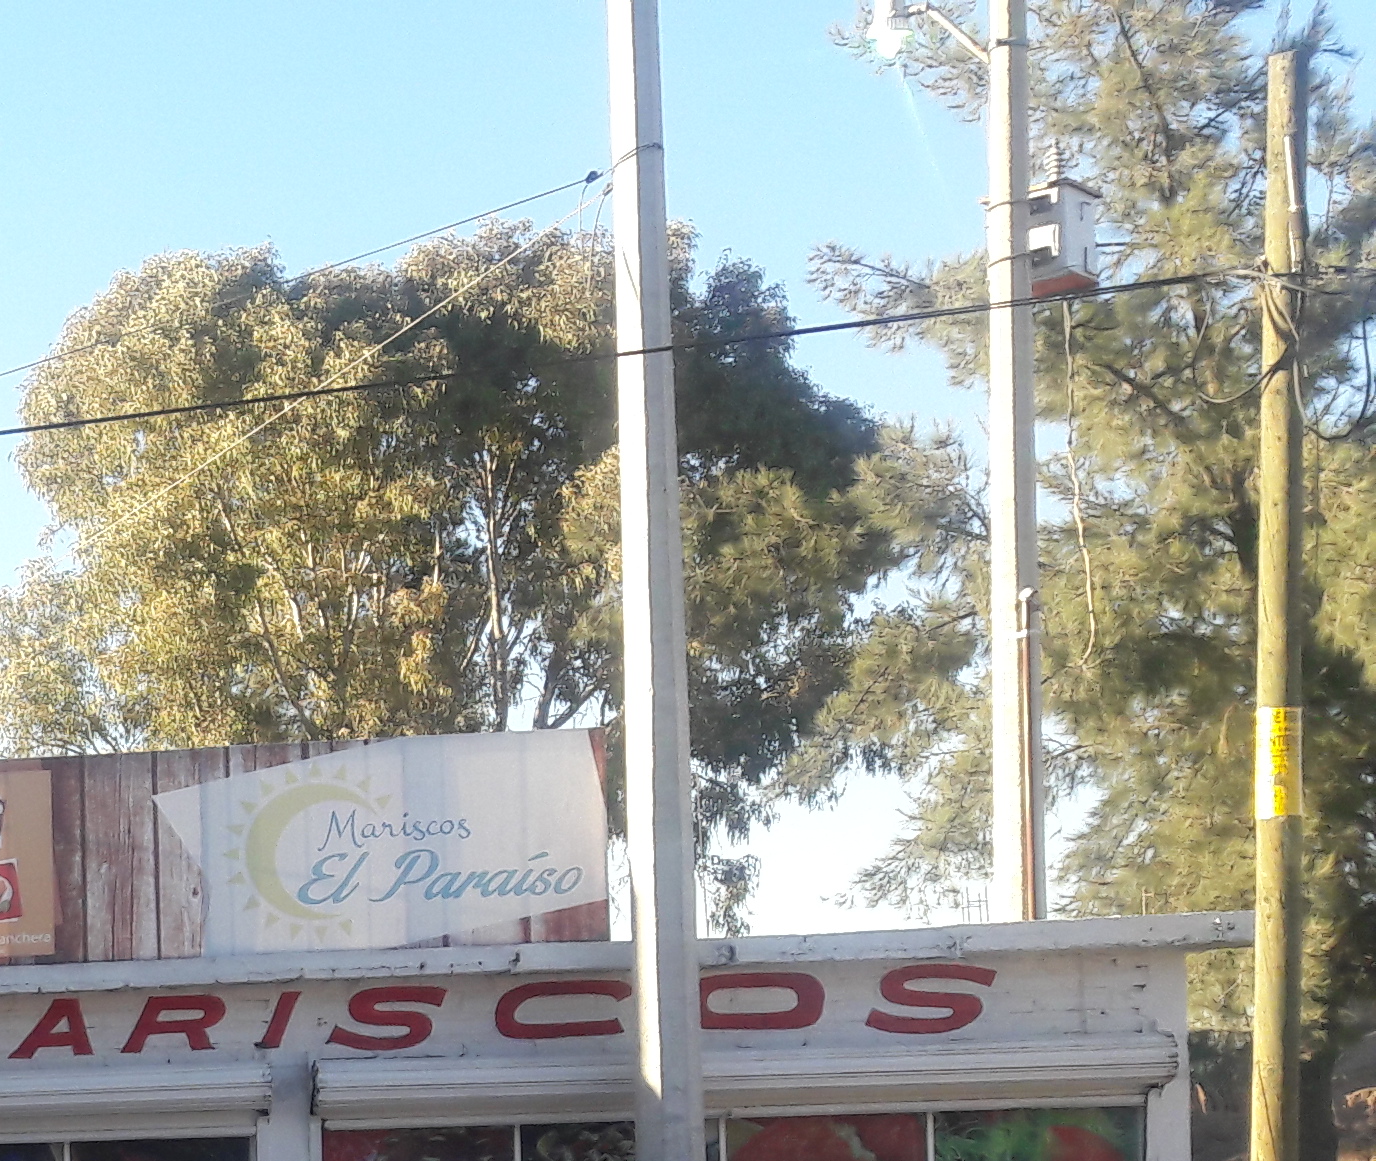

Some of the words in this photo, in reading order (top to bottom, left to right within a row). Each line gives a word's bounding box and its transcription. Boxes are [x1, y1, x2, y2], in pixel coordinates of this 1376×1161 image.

[318, 809, 472, 851] Mariscos
[297, 851, 370, 905] El
[369, 850, 586, 903] Paraíso
